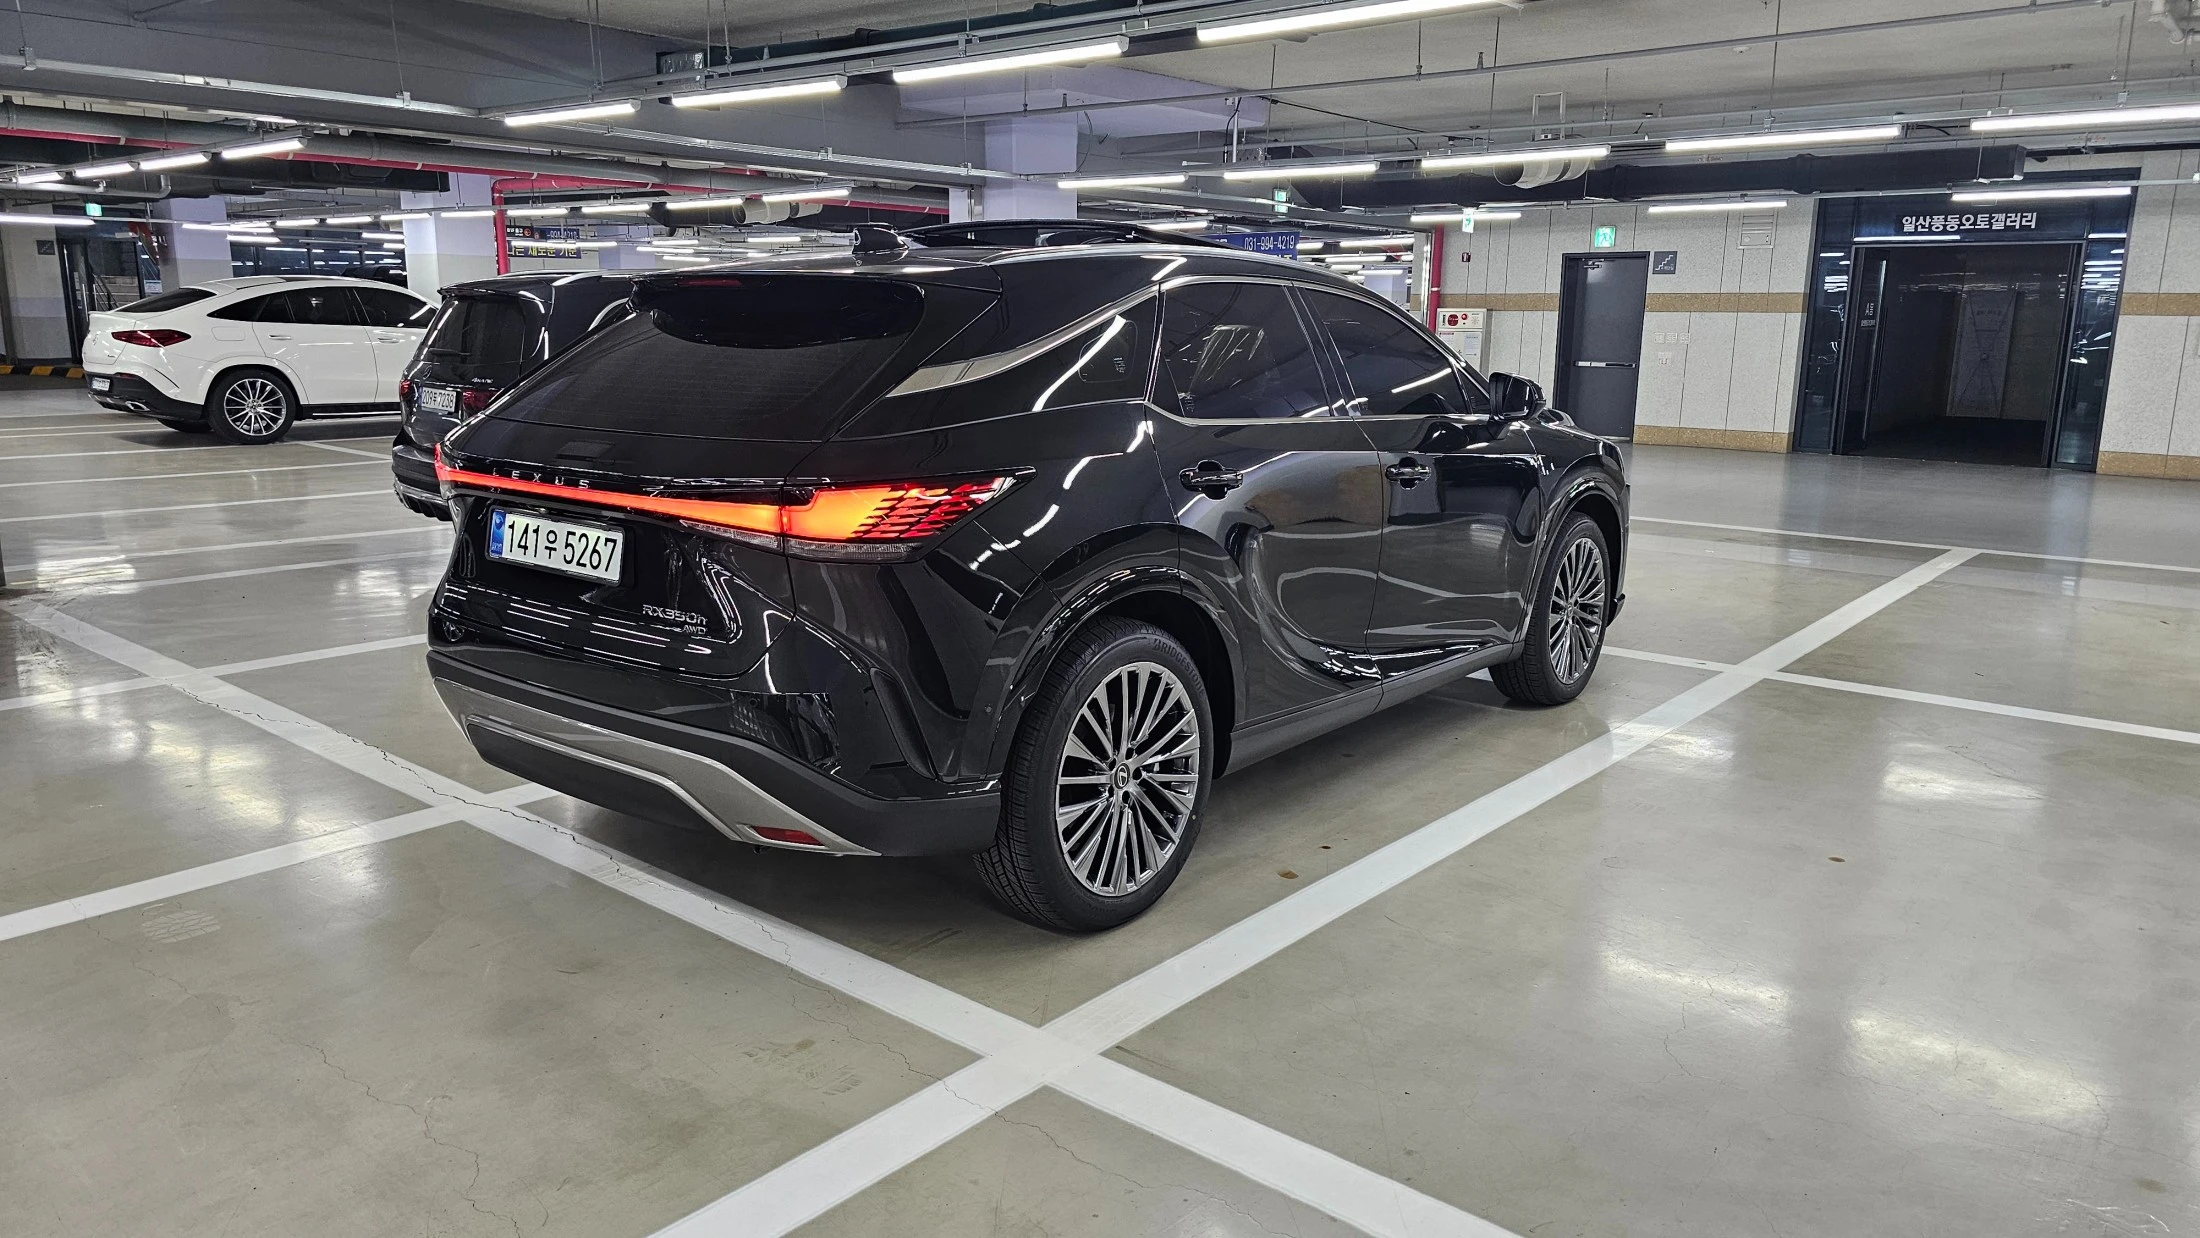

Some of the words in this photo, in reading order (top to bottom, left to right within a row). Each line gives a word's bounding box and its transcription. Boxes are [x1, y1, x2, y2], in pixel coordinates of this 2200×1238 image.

[1902, 212, 2037, 232] 일산풍동오토갤러리
[528, 244, 556, 257] 새로운
[1244, 235, 1295, 251] 031-994-4219
[492, 467, 590, 489] LEXUS
[508, 520, 618, 572] 141우5267
[642, 604, 708, 625] RX350h
[682, 624, 707, 635] AWD
[1152, 637, 1207, 697] BRIDGESTONE
